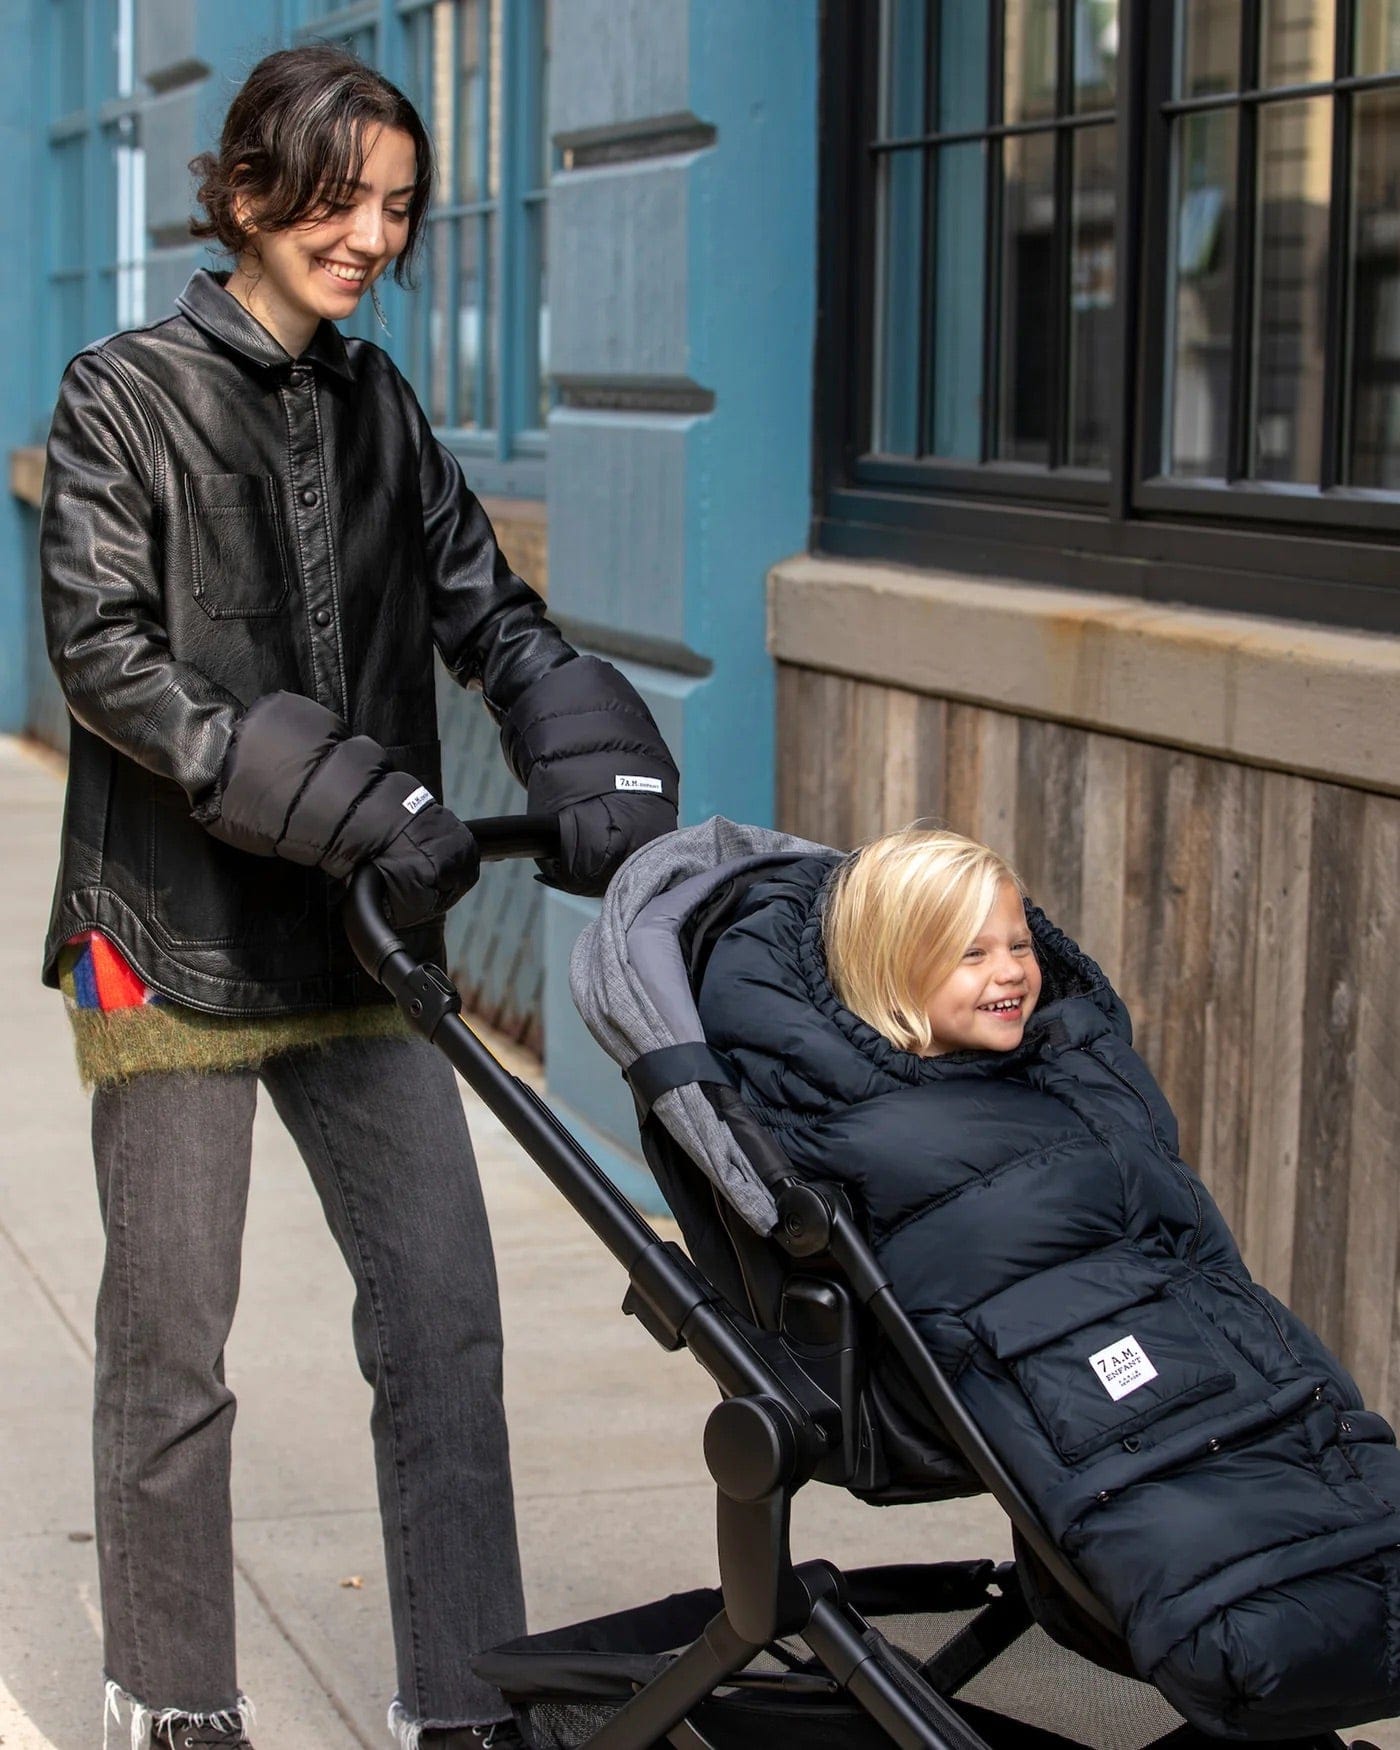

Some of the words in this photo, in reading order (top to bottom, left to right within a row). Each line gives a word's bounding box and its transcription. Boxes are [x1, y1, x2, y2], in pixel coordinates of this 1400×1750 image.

[1097, 1359, 1106, 1373] 7
[1111, 1348, 1138, 1367] A.M.
[1105, 1356, 1141, 1382] ENFANT
